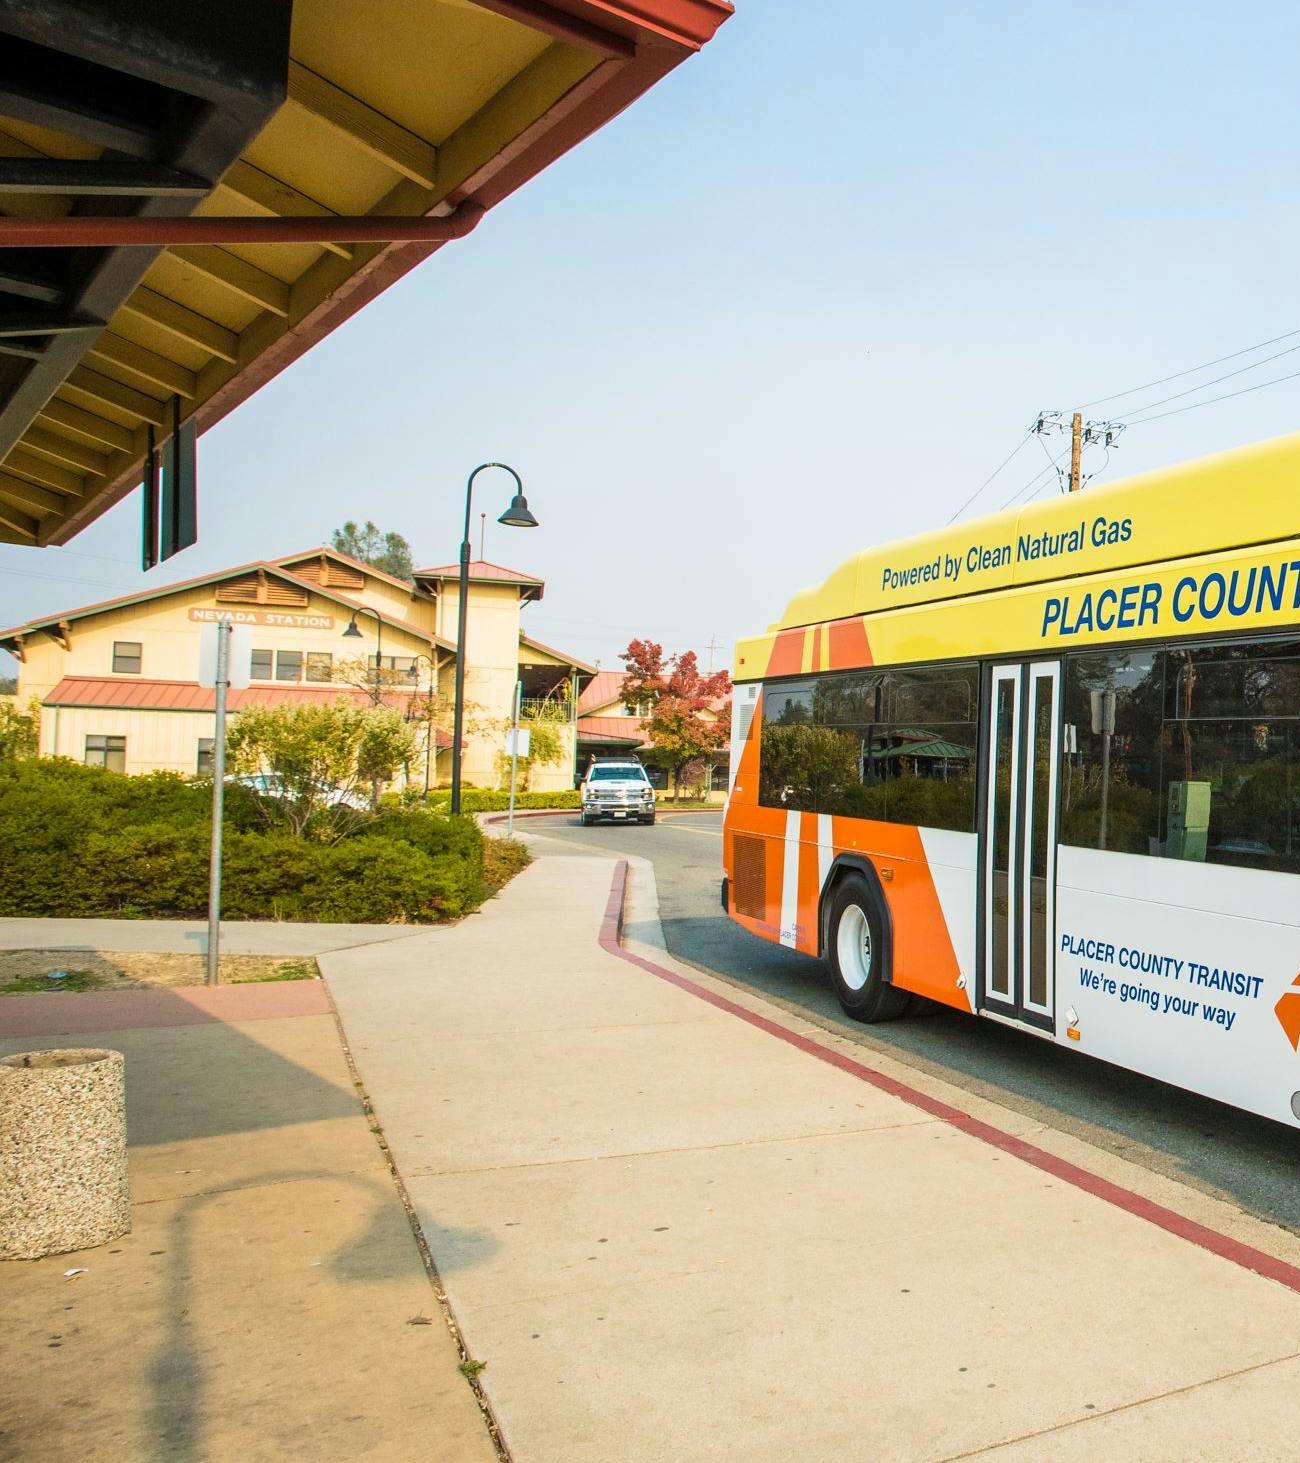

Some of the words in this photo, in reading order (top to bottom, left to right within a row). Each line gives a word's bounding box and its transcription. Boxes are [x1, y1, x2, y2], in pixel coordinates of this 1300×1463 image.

[882, 556, 941, 591] Powered
[944, 553, 962, 582] by
[966, 545, 1011, 573] Clean
[1016, 521, 1085, 563] Natural
[1091, 517, 1132, 548] Gas
[193, 610, 257, 622] NEVADA
[265, 613, 330, 626] STATION
[1041, 582, 1162, 637] PLACER
[1061, 934, 1115, 965] PLACER
[1118, 947, 1185, 981] COUNTY
[1187, 962, 1264, 999] TRANSIT
[1079, 967, 1117, 995] We're
[1120, 982, 1160, 1012] going
[1163, 993, 1199, 1018] your
[1203, 1004, 1236, 1031] way
